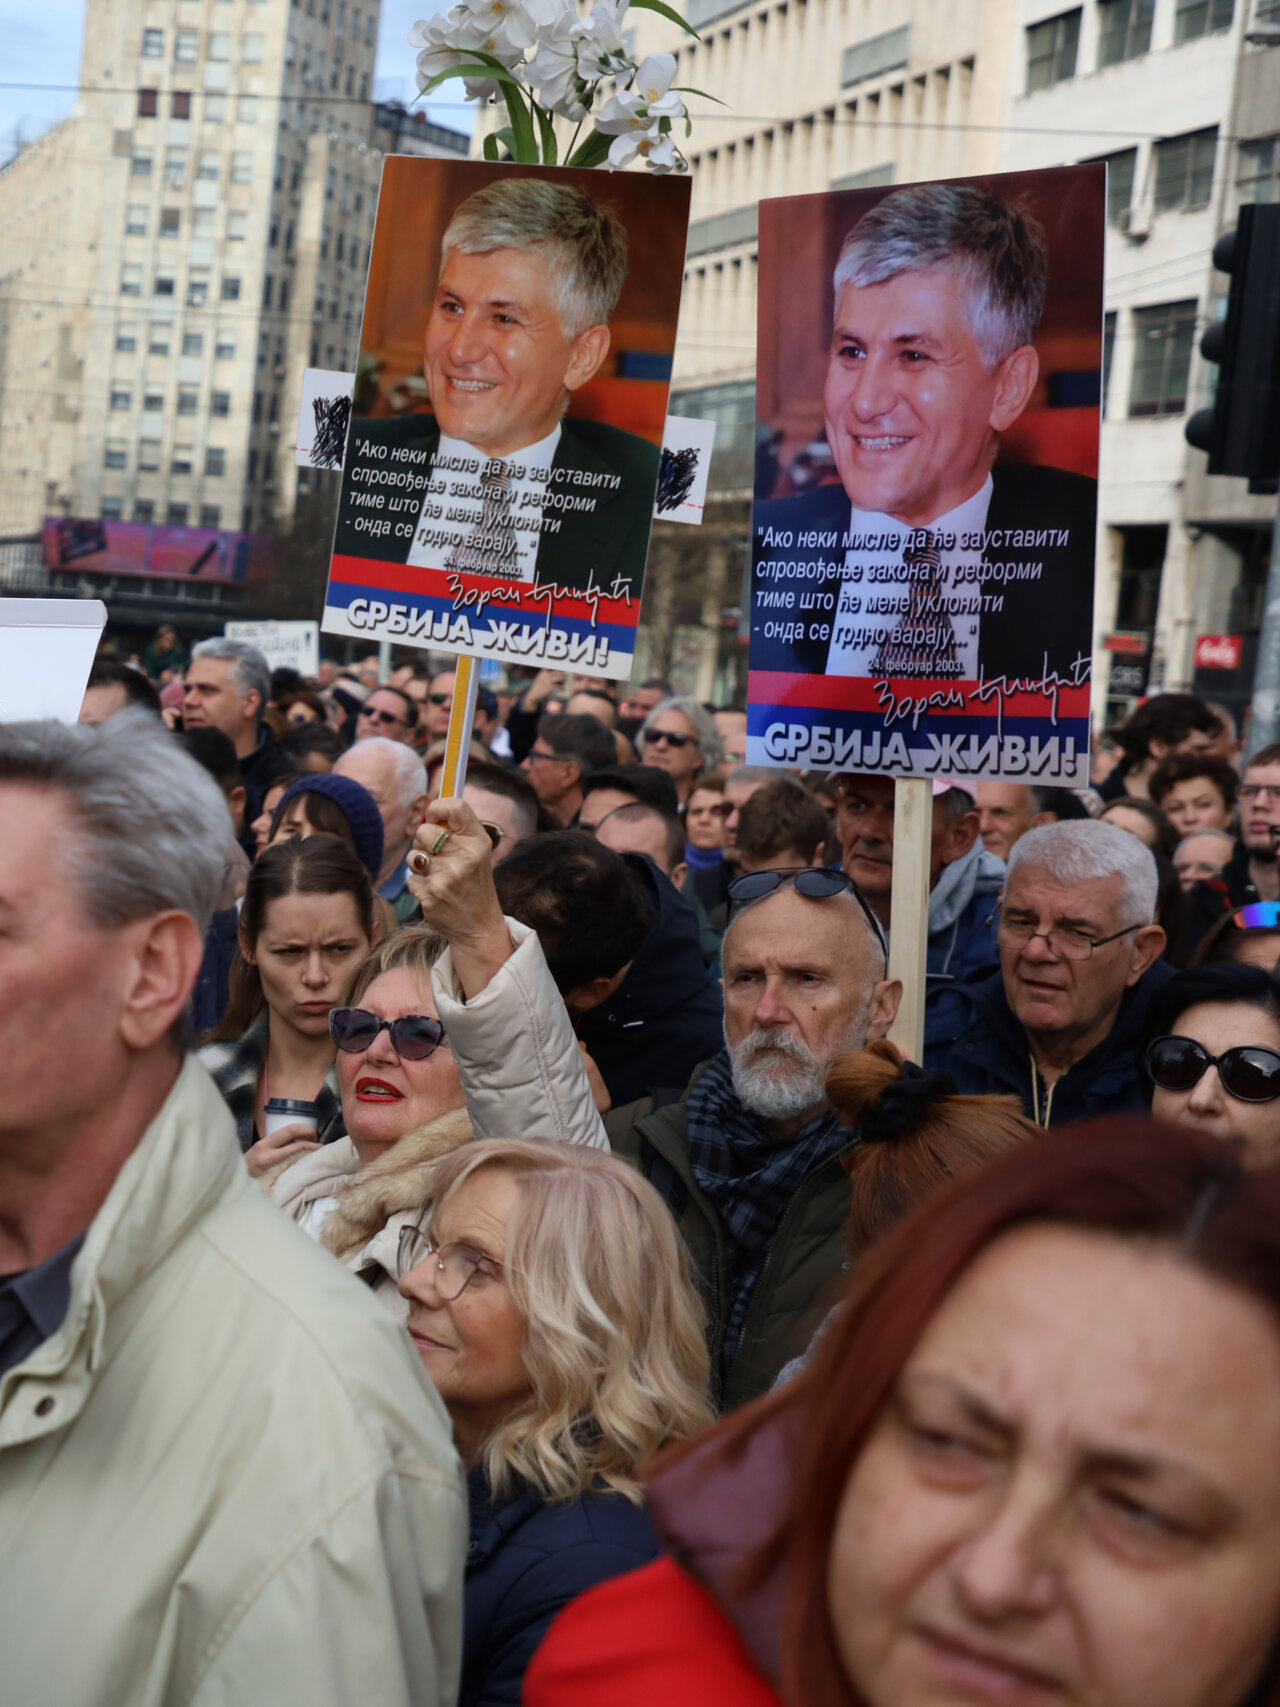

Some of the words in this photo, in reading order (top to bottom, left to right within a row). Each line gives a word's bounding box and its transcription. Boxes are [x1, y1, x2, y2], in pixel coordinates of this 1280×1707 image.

[355, 438, 388, 460] "Ако
[390, 447, 427, 465] неки
[429, 452, 480, 472] мисле
[481, 459, 501, 477] да
[505, 460, 525, 479] ће
[529, 467, 621, 490] зауставити
[351, 467, 446, 493] спровођење
[449, 481, 501, 501] закона
[506, 490, 518, 504] и
[519, 488, 597, 513] реформи
[349, 492, 385, 509] тиме
[388, 497, 420, 514] што
[423, 500, 443, 519] ће
[445, 506, 483, 523] мене
[487, 511, 562, 533] уклонити
[354, 517, 392, 538] онда
[395, 523, 414, 538] се
[417, 528, 462, 549] грдно
[758, 526, 793, 548] "Ако
[797, 531, 838, 548] неки
[841, 531, 900, 551] мисле
[904, 530, 927, 552] да
[932, 528, 955, 549] ће
[960, 529, 1070, 554] зауставити
[458, 560, 498, 572] фебруар
[756, 557, 862, 584] спровођење
[867, 562, 930, 583] закона
[935, 564, 949, 582] и
[952, 557, 1043, 588] реформи
[756, 591, 795, 609] тиме
[799, 592, 834, 610] што
[840, 591, 861, 613] ће
[865, 595, 910, 614] мене
[916, 595, 1005, 618] уклонити
[346, 598, 474, 647] СРБИЈА
[482, 618, 610, 668] ЖИВИ!
[764, 621, 805, 644] онда
[809, 623, 830, 641] се
[835, 627, 887, 650] грдно
[868, 659, 882, 671] 24.
[886, 660, 933, 675] фебруар
[764, 721, 913, 772] СРБИЈА
[924, 732, 1077, 778] ЖИВИ!
